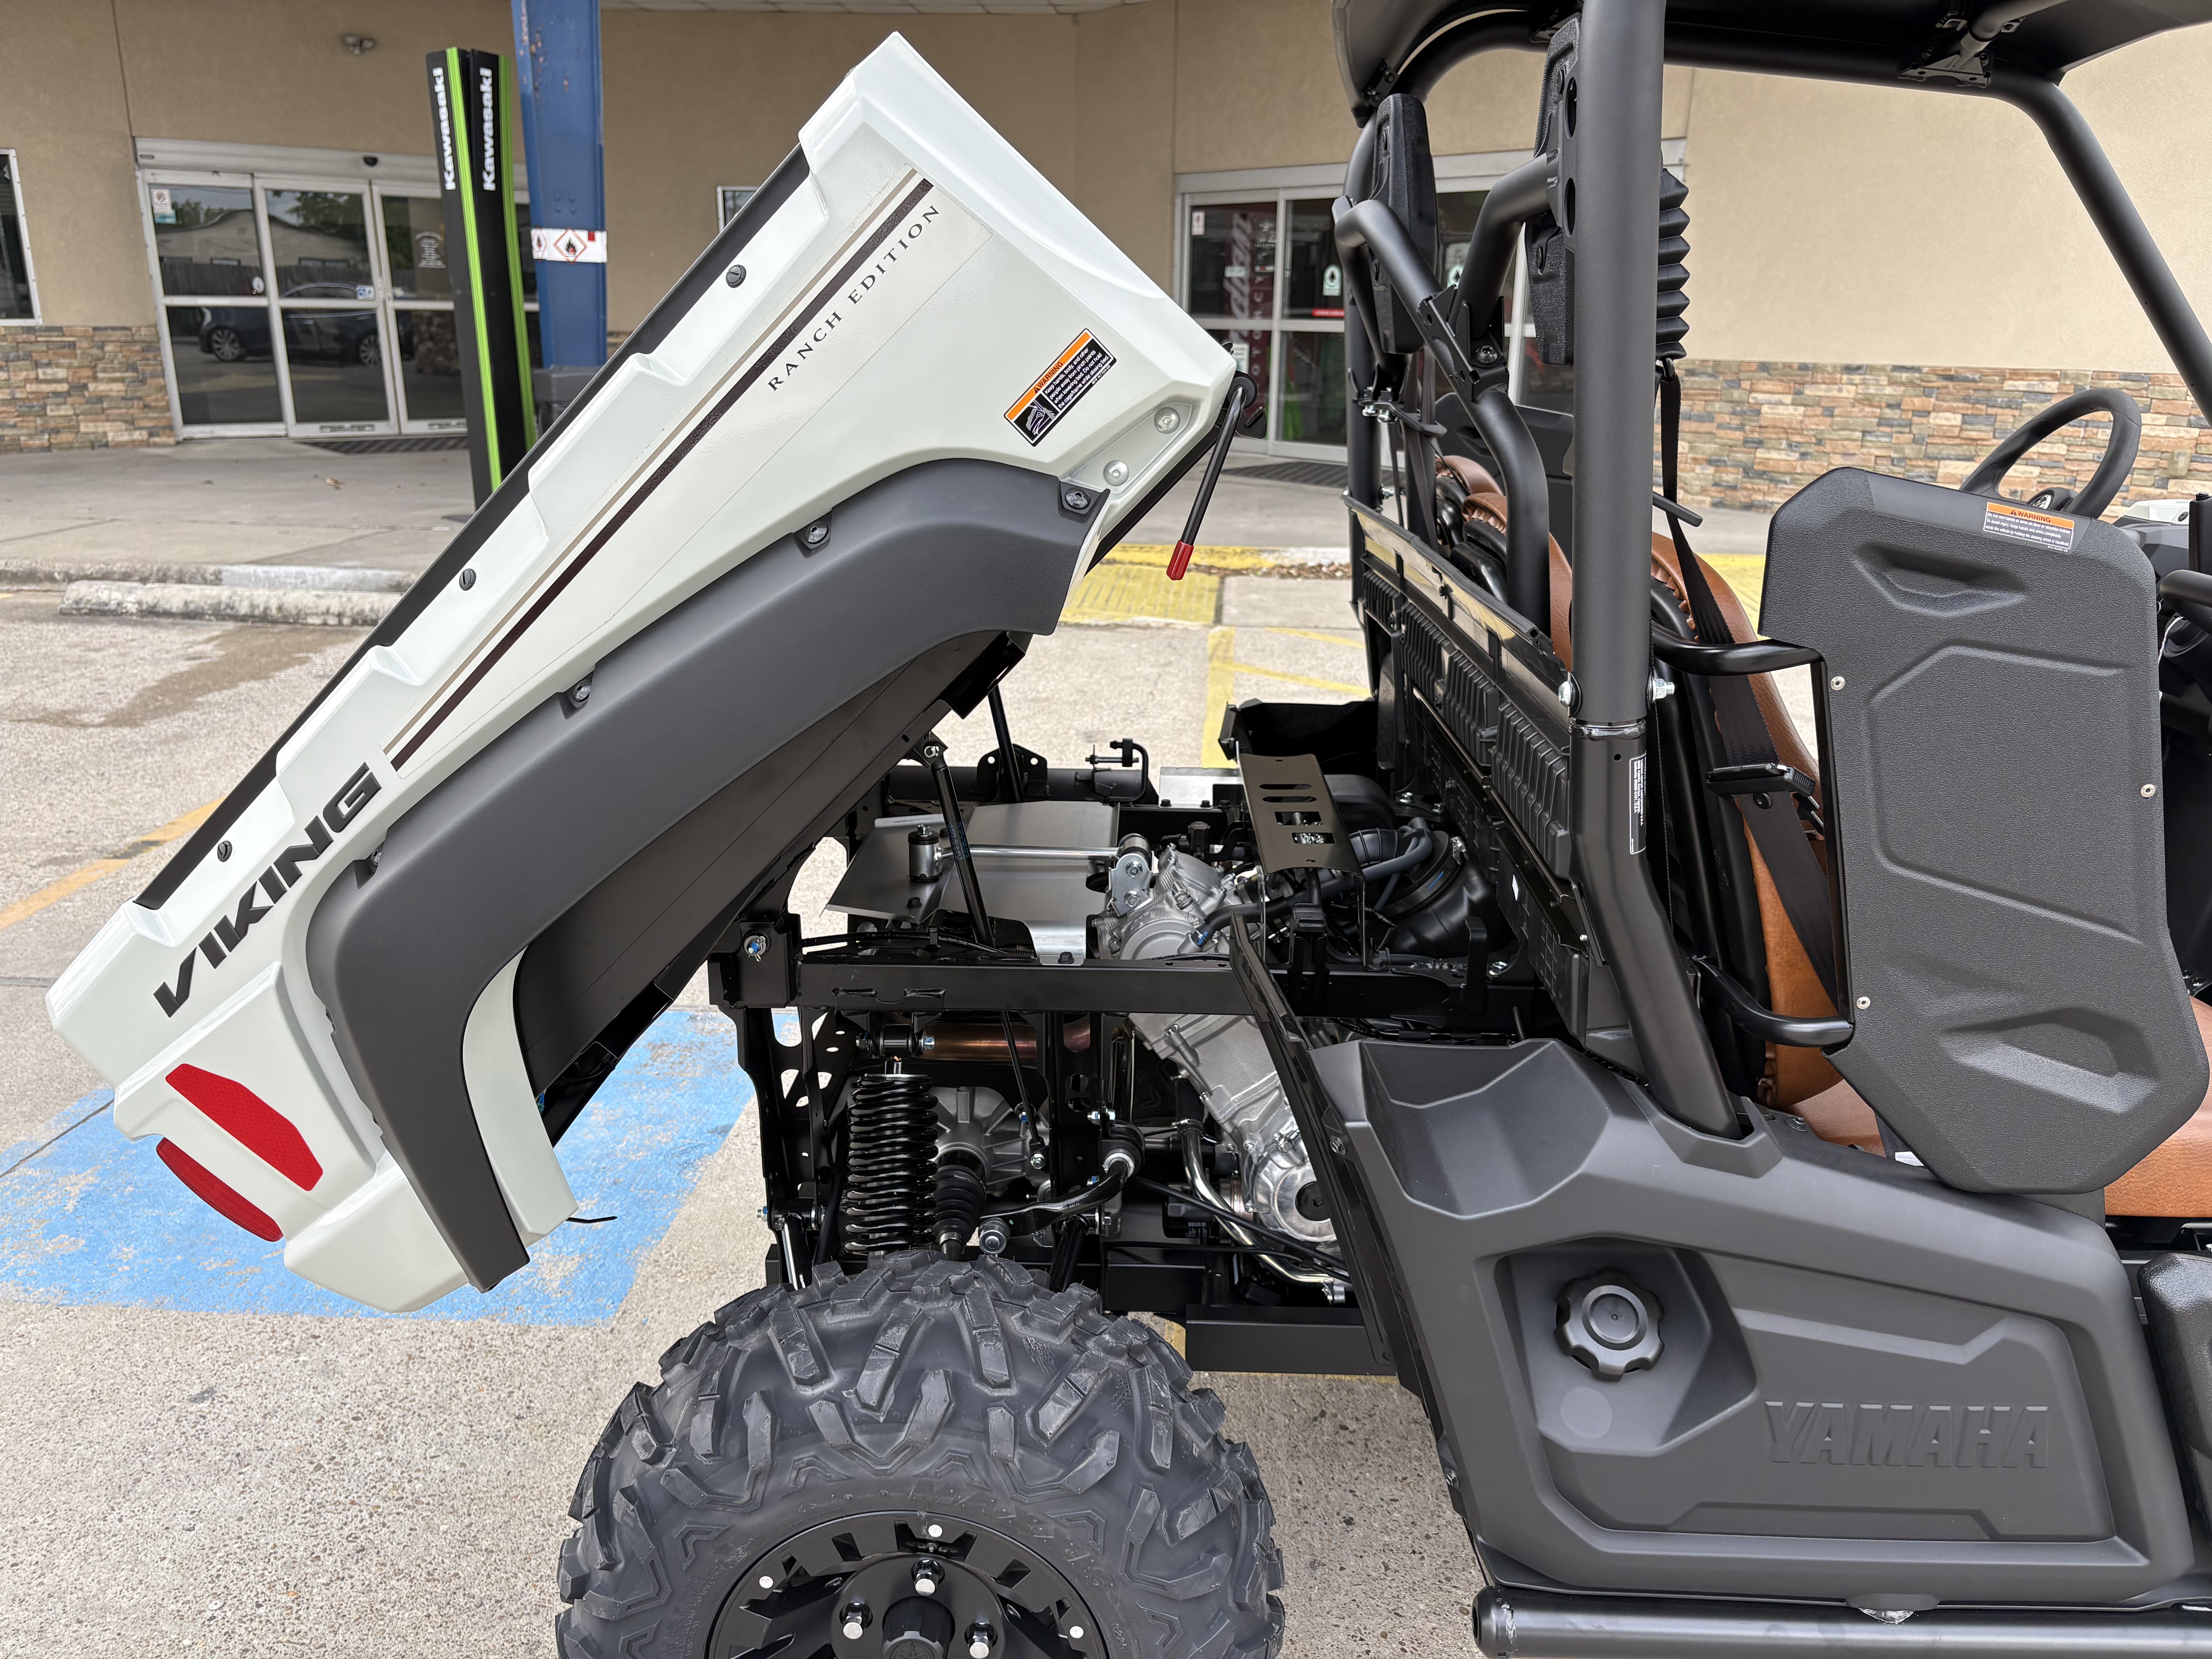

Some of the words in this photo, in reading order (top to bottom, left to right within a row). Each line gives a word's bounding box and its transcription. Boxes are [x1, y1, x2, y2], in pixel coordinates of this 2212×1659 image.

[433, 67, 456, 190] Kawasaki
[479, 67, 496, 191] Kawasaki
[767, 310, 843, 392] RANCH
[847, 204, 940, 306] EDITION
[1038, 361, 1063, 388] WARNING
[1044, 384, 1054, 394] Keep
[1053, 374, 1065, 385] hands,
[1063, 364, 1074, 374] body,
[1079, 347, 1088, 358] other
[1049, 386, 1061, 400] people
[1060, 378, 1070, 388] away
[1068, 369, 1077, 379] from
[1076, 360, 1086, 371] pinch
[1085, 350, 1096, 362] points
[1054, 393, 1064, 403] when
[1062, 379, 1077, 394] lowering
[1075, 372, 1084, 381] bed.
[1093, 352, 1102, 362] hold
[1064, 383, 1082, 402] cage/frame
[1081, 374, 1091, 384] while
[1090, 362, 1102, 375] closing
[1100, 355, 1109, 364] bed.
[2017, 510, 2051, 523] WARNING
[153, 761, 382, 1018] VIKING
[1765, 1401, 2049, 1468] YAMAHA
